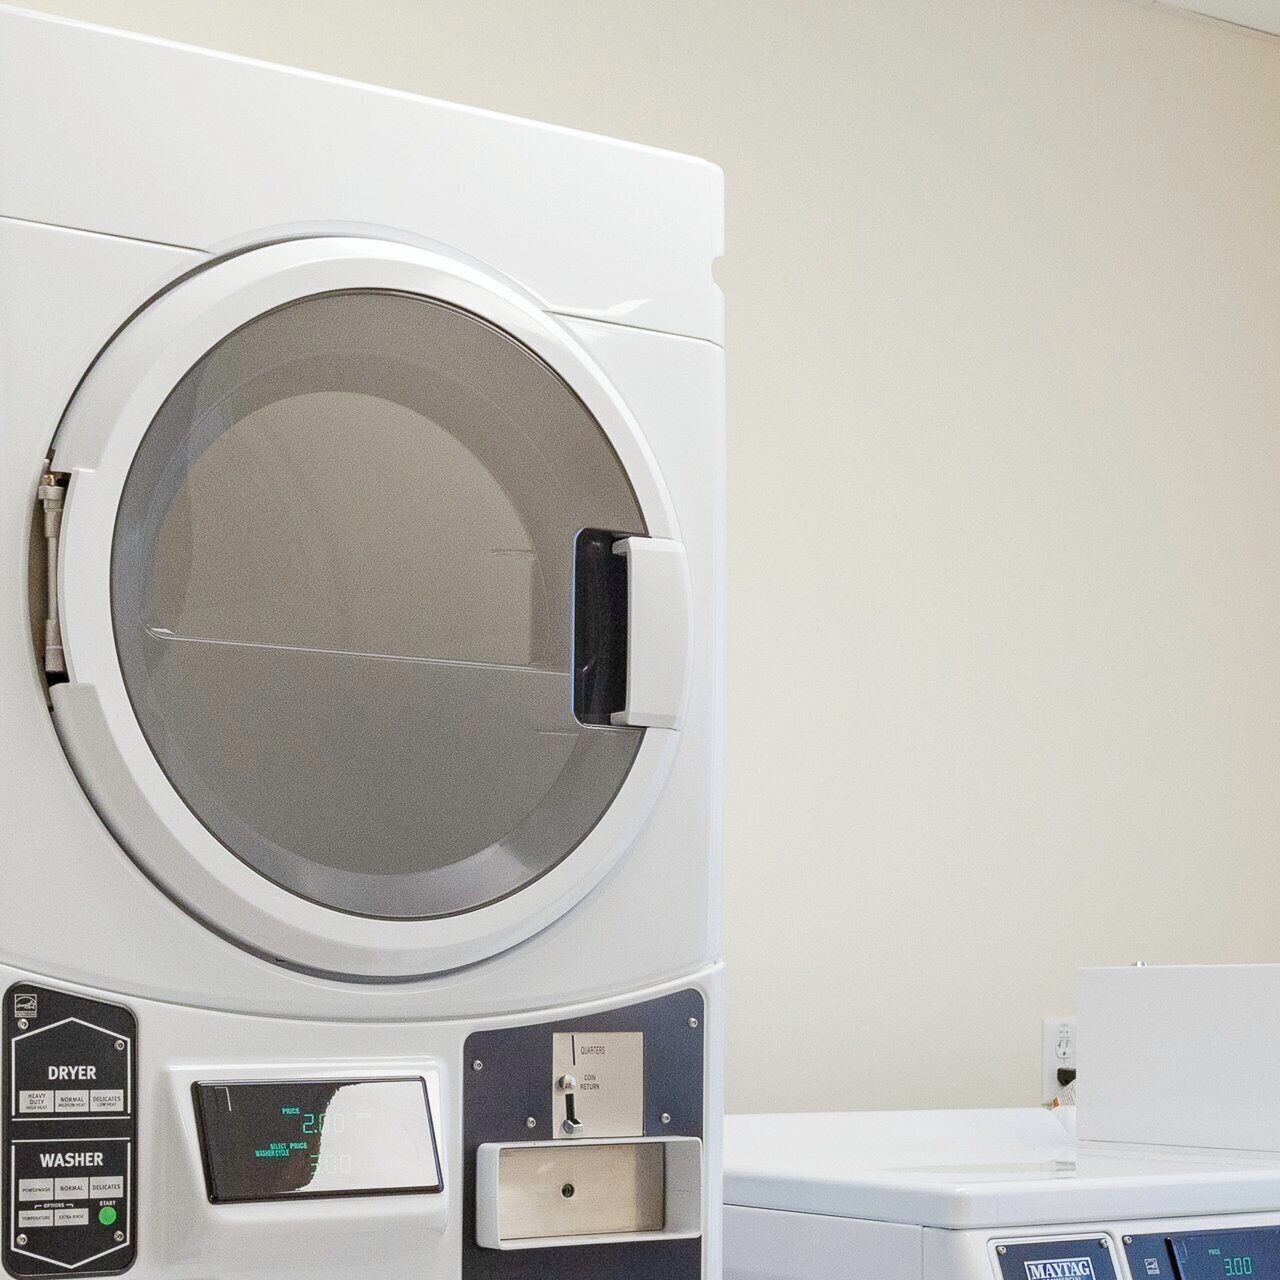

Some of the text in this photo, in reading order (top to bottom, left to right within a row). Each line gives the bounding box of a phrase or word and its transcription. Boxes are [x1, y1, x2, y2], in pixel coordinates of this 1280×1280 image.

[48, 1065, 97, 1080] DRYER
[40, 1152, 104, 1168] WASHER
[1028, 1261, 1090, 1279] MAYTAG
[1224, 1257, 1252, 1276] 3.00
